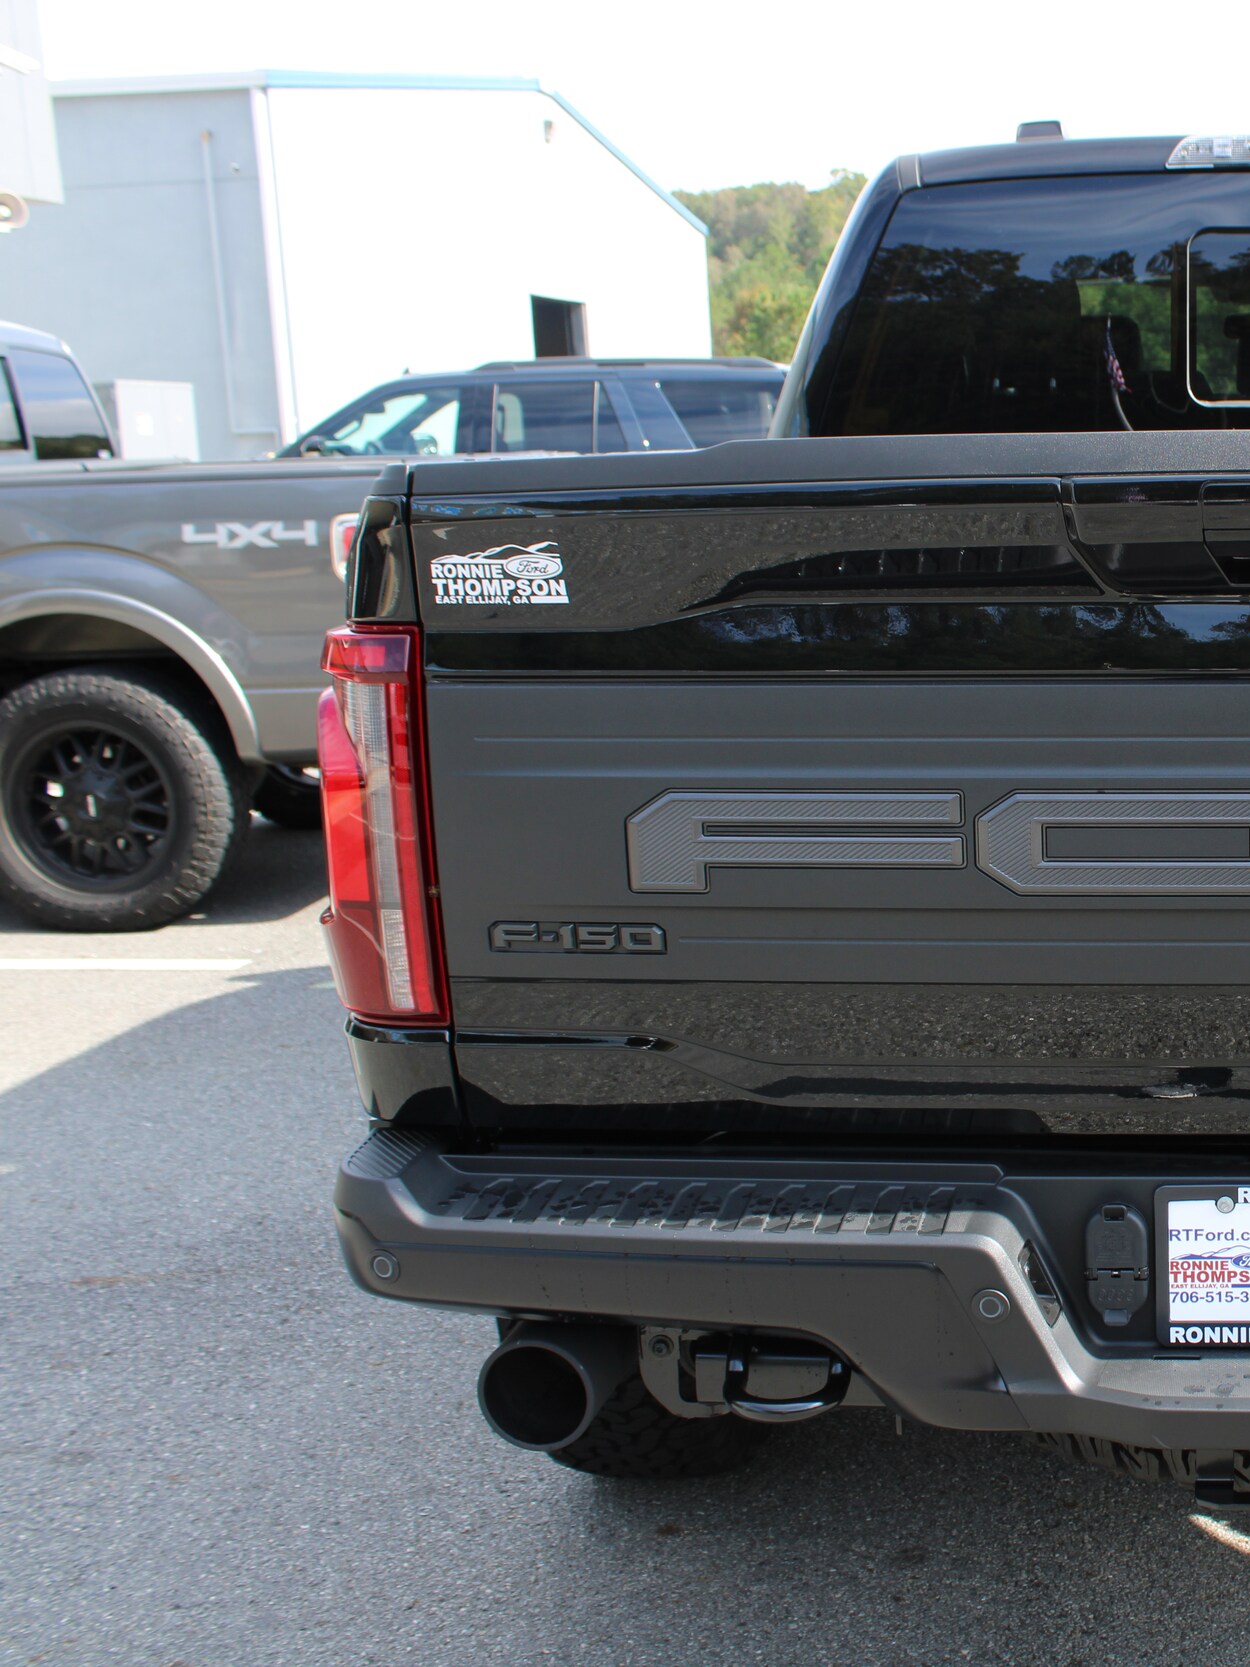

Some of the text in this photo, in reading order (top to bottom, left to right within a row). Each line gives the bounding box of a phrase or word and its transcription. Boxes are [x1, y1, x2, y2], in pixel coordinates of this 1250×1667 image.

[181, 520, 318, 548] 4X4
[431, 564, 504, 579] RONNIE
[517, 560, 549, 574] Ford
[432, 579, 568, 597] THOMPSON
[435, 596, 530, 606] EAST ELLIJAY, GA
[488, 920, 667, 954] F-150
[1170, 1260, 1229, 1271] RONNIE
